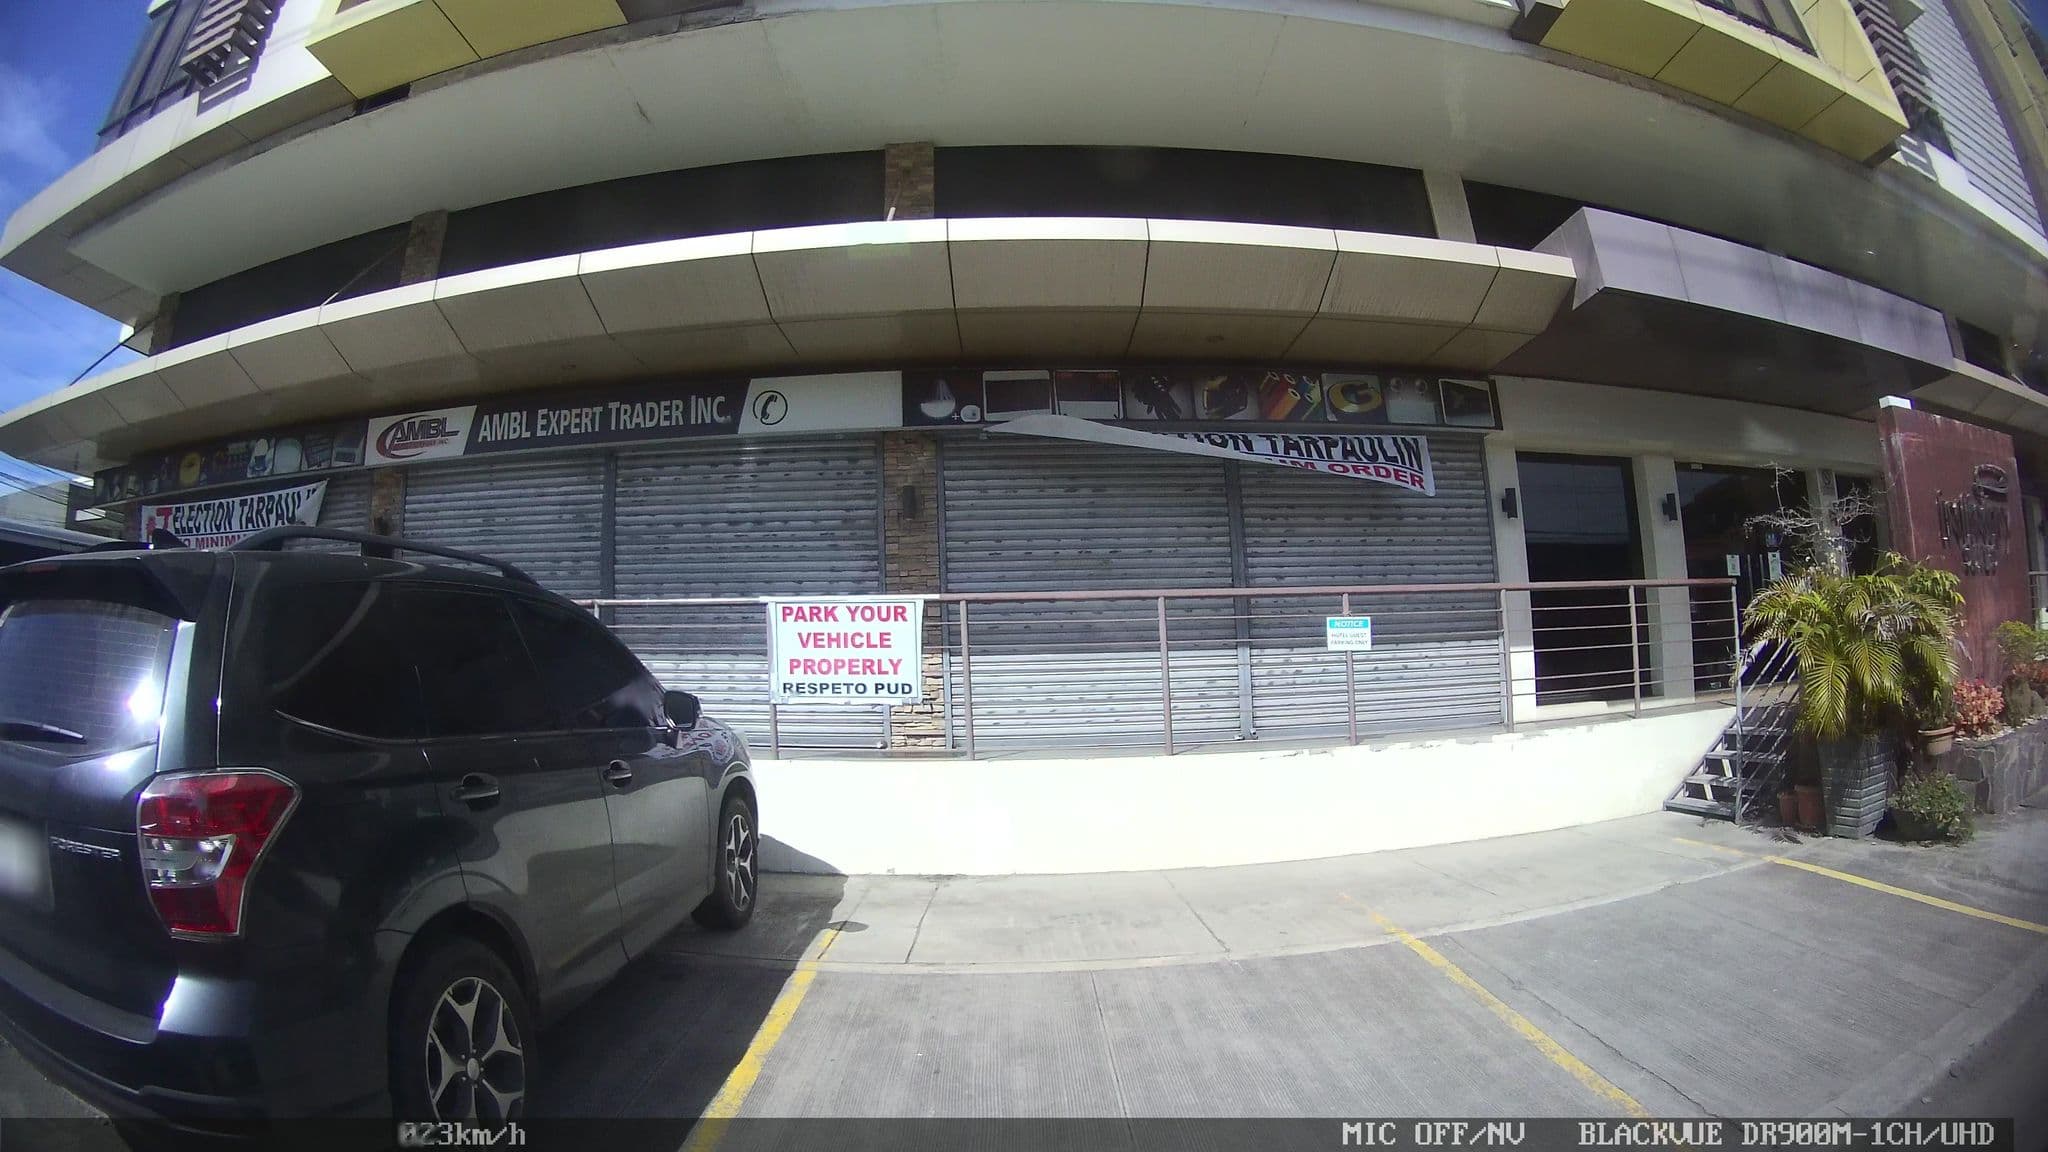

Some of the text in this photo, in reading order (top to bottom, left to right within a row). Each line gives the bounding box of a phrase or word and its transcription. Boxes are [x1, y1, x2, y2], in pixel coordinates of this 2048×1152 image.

[391, 417, 460, 444] AMBL
[478, 411, 531, 443] AMBL
[536, 406, 603, 438] EXPERT
[608, 400, 684, 431] TRADER
[1257, 434, 1423, 471] TARPAULIN
[1327, 463, 1425, 490] ORDER
[173, 500, 236, 535] ELECTION
[782, 605, 908, 623] PARK YOUR
[1335, 619, 1364, 628] NOTICE
[797, 632, 892, 649] VEHICLE
[789, 658, 903, 675] PROPERLY
[782, 683, 913, 695] RESPETO PUD
